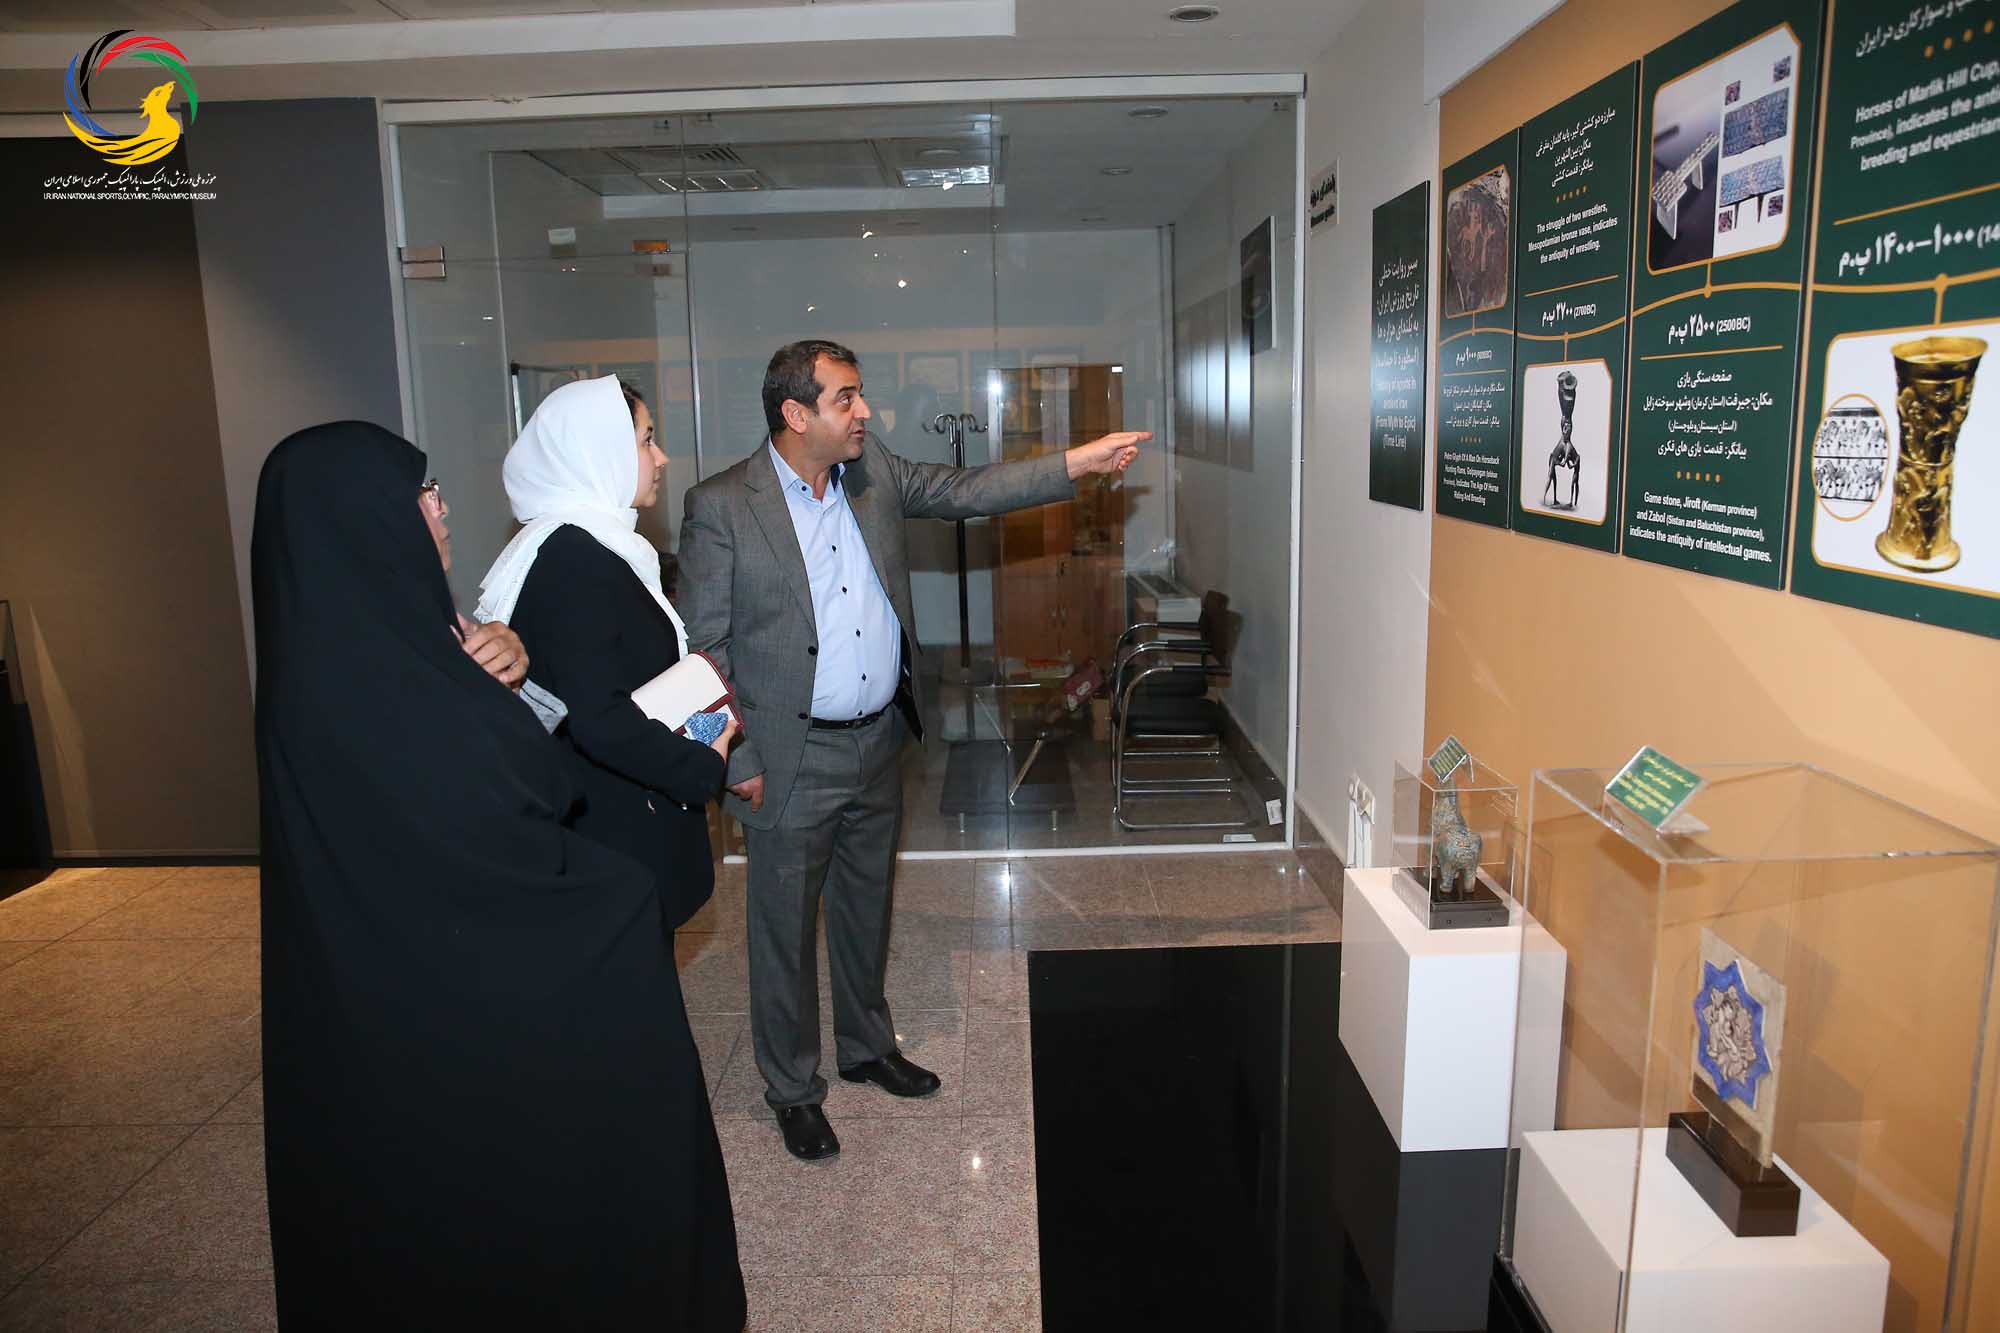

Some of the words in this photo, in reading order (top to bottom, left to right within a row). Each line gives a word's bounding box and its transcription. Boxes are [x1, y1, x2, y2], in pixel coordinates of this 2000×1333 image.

[1856, 25, 1881, 57] ایران
[1856, 100, 1893, 123] Horses
[1894, 90, 1907, 109] of
[1946, 68, 1968, 92] Hill
[1896, 106, 1949, 135] indicates
[1951, 98, 1972, 117] the
[1861, 147, 1908, 171] breeding
[1909, 135, 1932, 157] and
[1537, 223, 1545, 234] The
[1546, 216, 1565, 230] struggle
[1566, 213, 1571, 224] of
[1572, 213, 1581, 223] two
[1561, 231, 1577, 242] bronze
[1593, 217, 1617, 232] indicates
[1549, 248, 1569, 261] antiquity
[1570, 245, 1575, 256] of
[1668, 323, 1688, 345] پ.م
[1690, 313, 1715, 337] ۲۵۰۰
[1703, 442, 1724, 454] قدمت
[1644, 492, 1661, 504] Game
[1662, 495, 1682, 509] stone,
[1683, 496, 1700, 510] Jiroft
[1701, 500, 1726, 514] (Kerman
[1727, 505, 1757, 520] province)
[1637, 510, 1648, 520] and
[1648, 511, 1665, 523] Zabol
[1685, 519, 1696, 529] and
[1697, 519, 1732, 534] Baluchistan
[1630, 525, 1655, 540] indicates
[1656, 530, 1666, 542] the
[1667, 533, 1694, 550] antiquity
[1695, 538, 1703, 549] of
[1703, 539, 1743, 557] intellectual
[1743, 548, 1772, 562] games.
